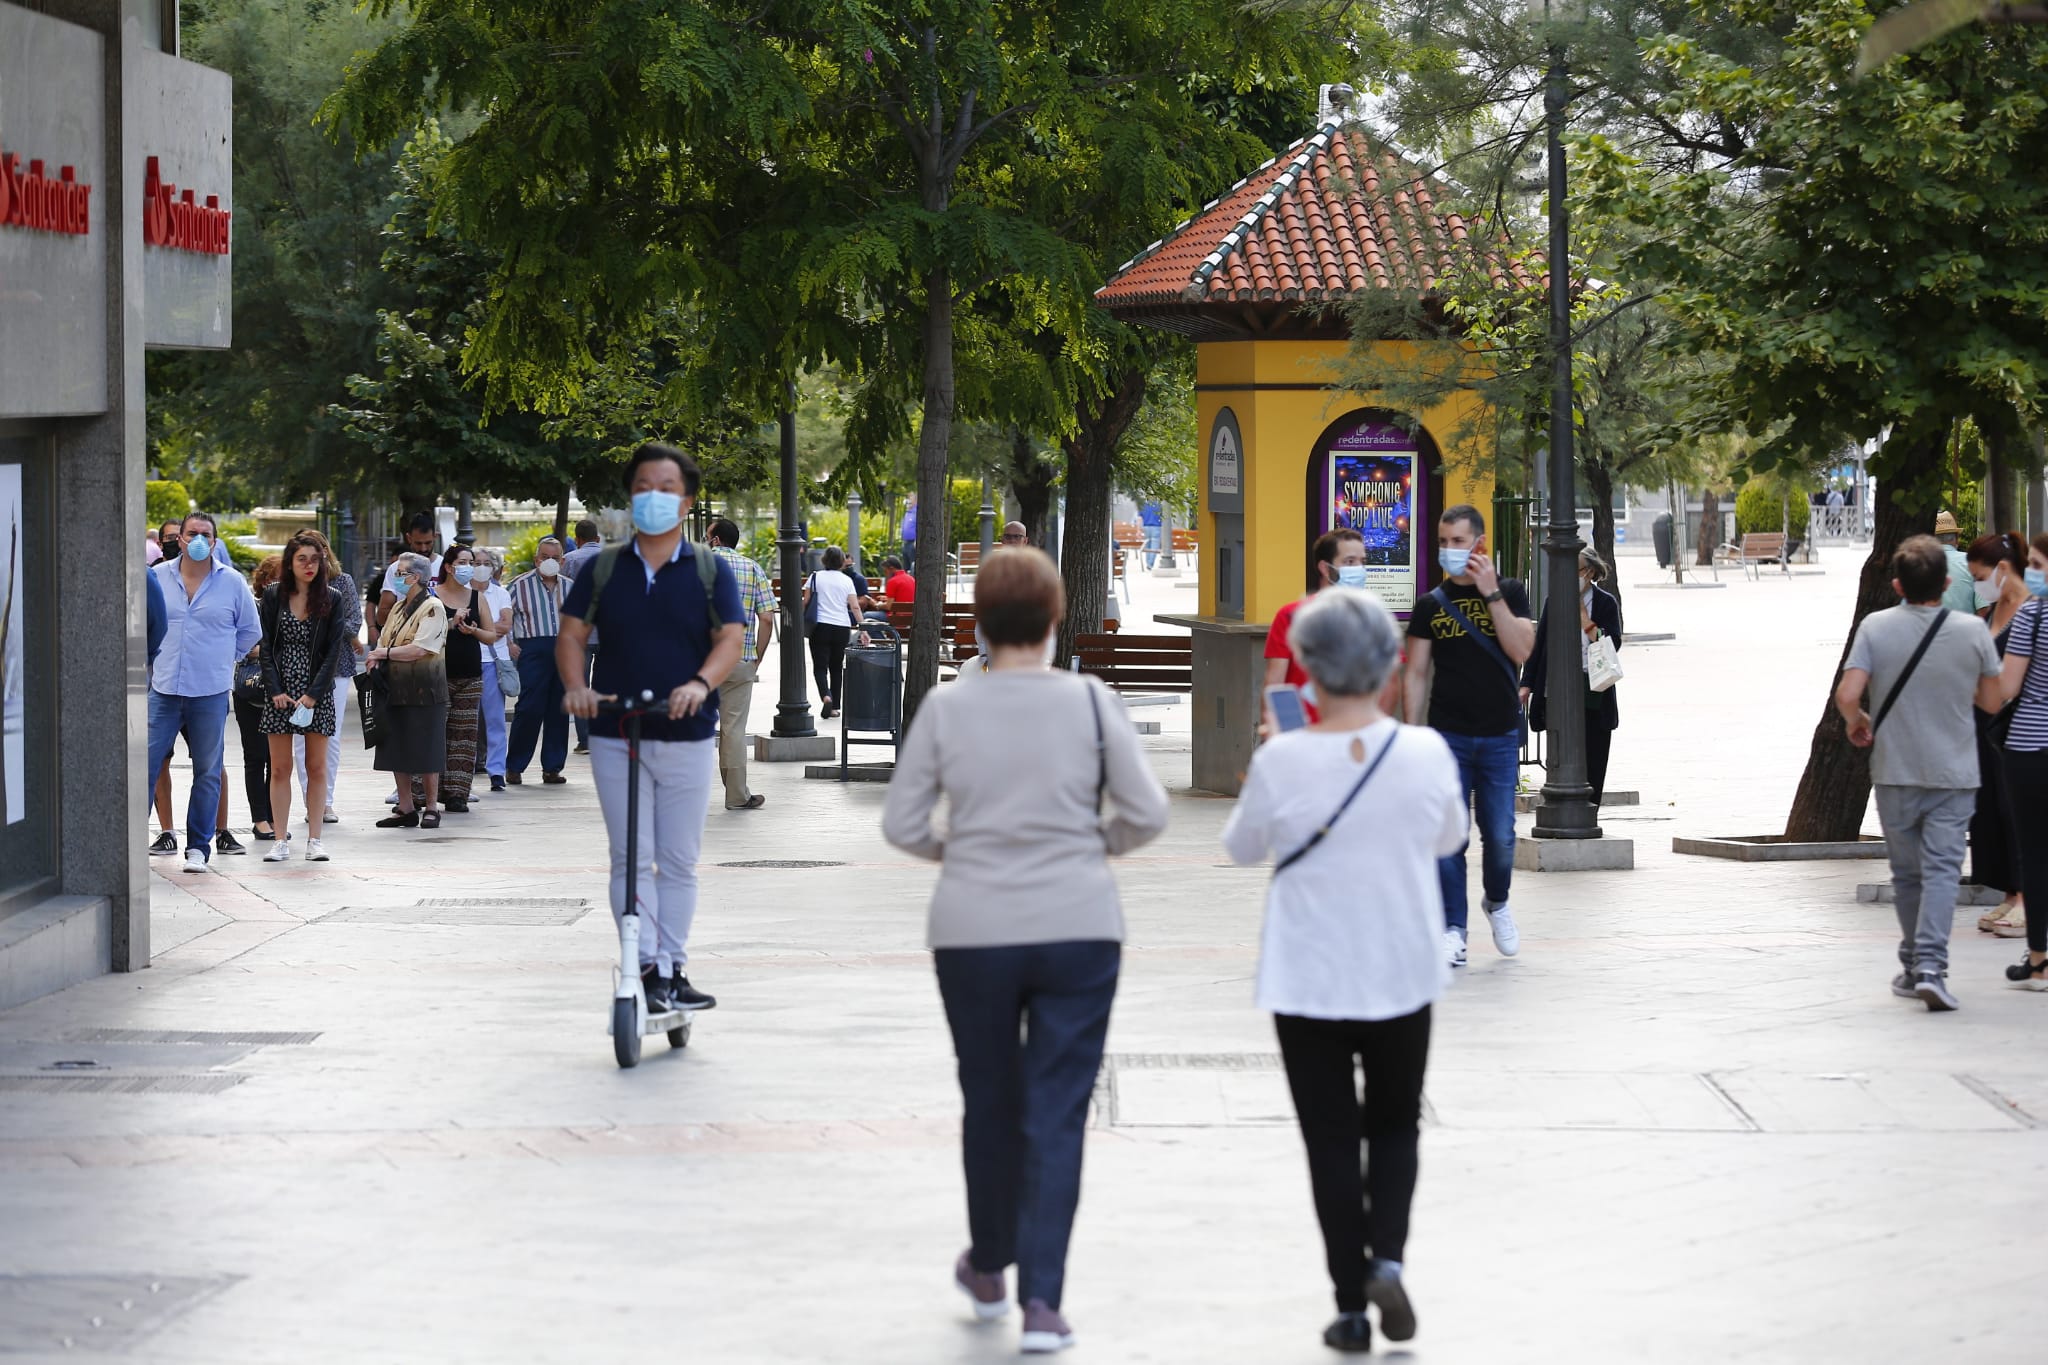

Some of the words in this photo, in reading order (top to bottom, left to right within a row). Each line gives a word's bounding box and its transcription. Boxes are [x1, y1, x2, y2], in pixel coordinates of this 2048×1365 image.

[12, 152, 91, 234] Santander
[168, 184, 231, 254] Santander
[1344, 481, 1401, 504] SYMPHONIC
[1350, 506, 1370, 528] POP
[1372, 507, 1393, 528] LIVE
